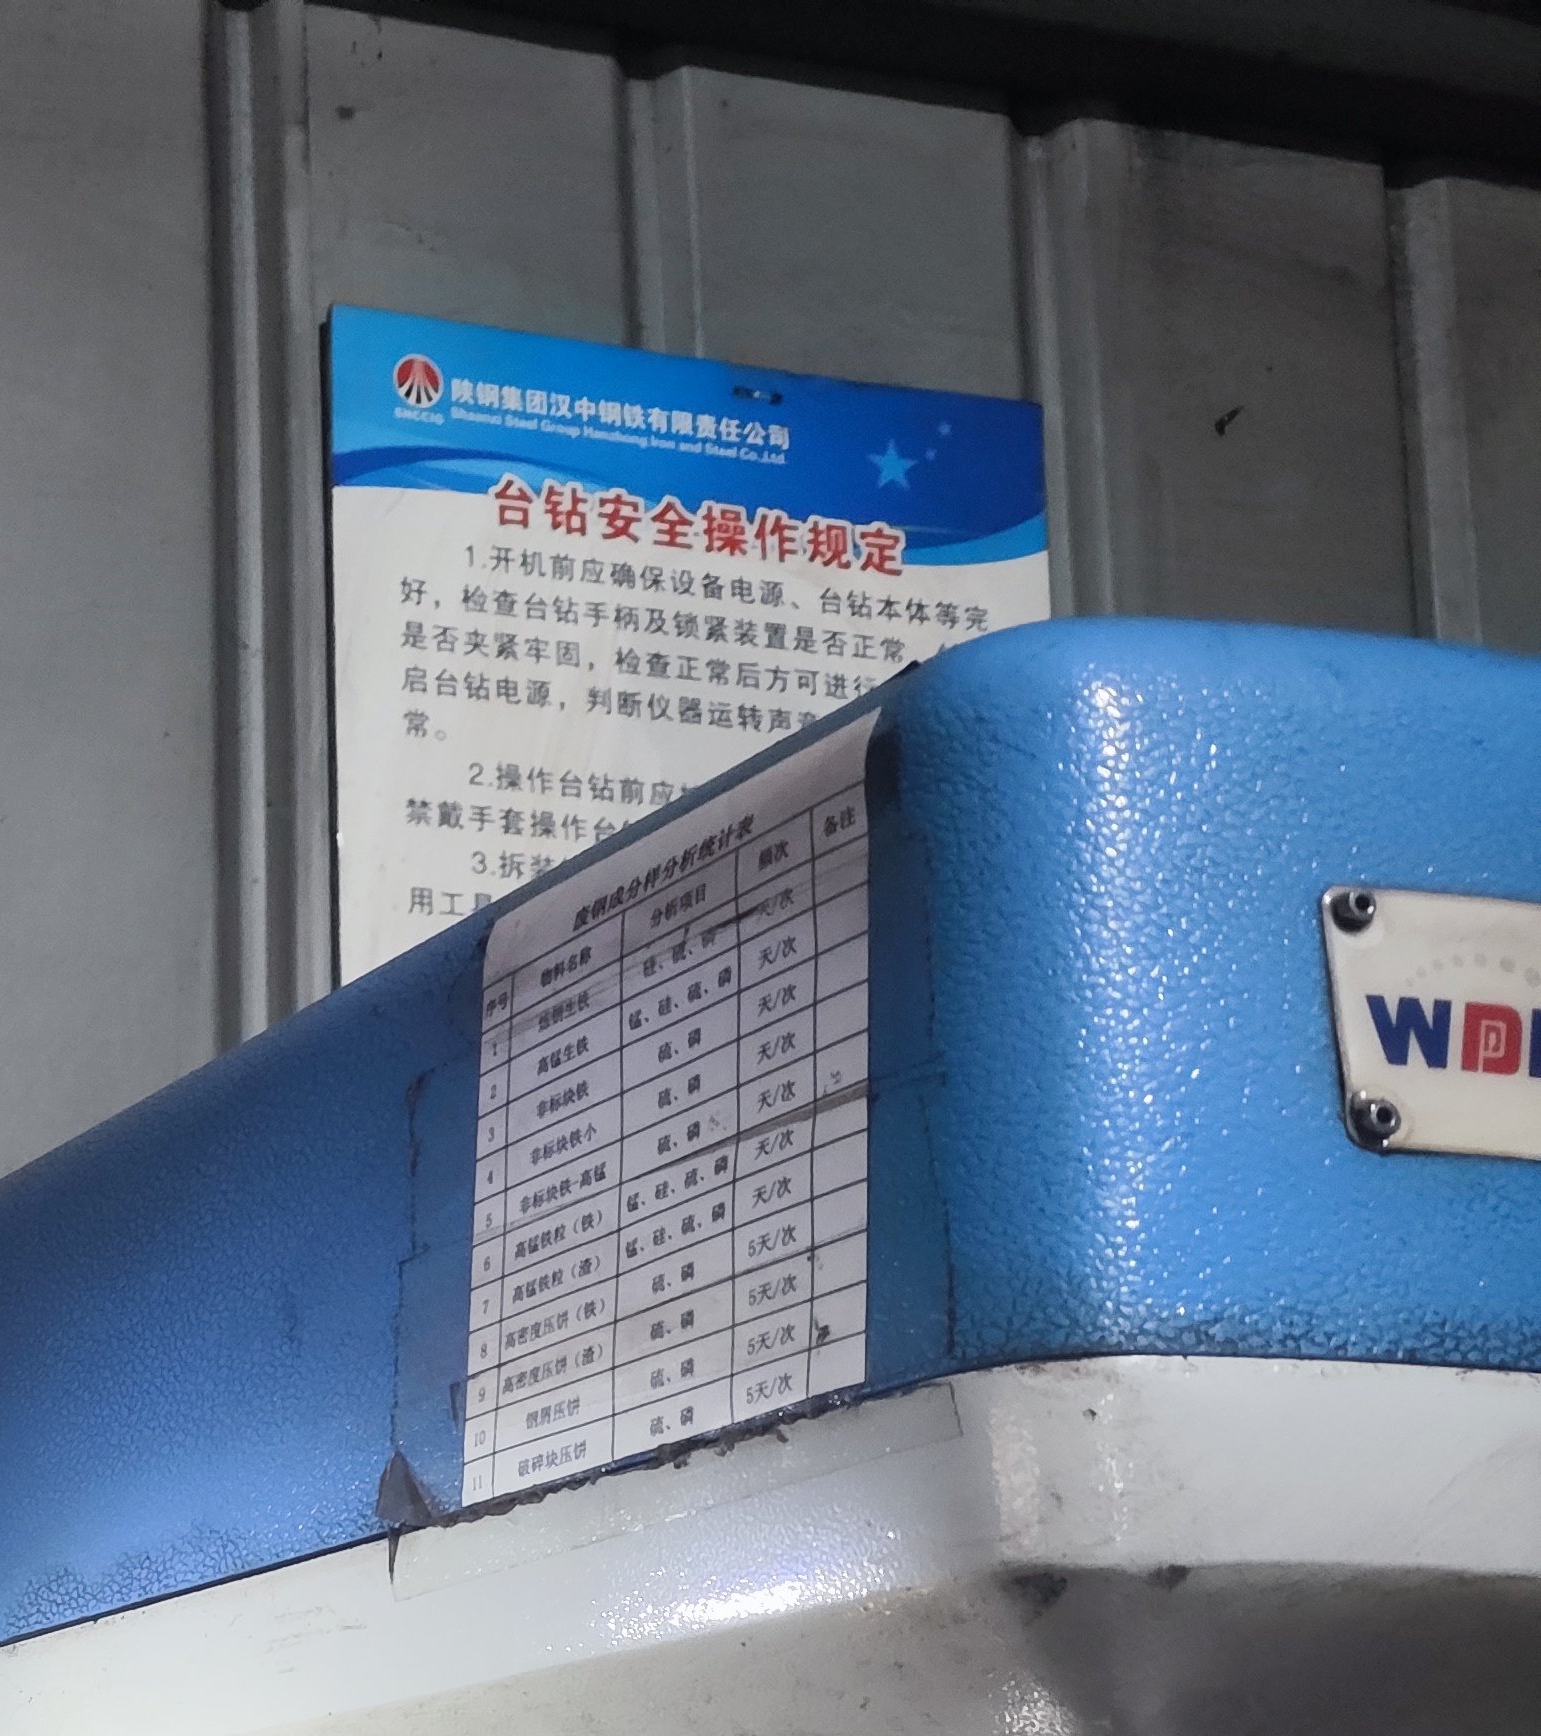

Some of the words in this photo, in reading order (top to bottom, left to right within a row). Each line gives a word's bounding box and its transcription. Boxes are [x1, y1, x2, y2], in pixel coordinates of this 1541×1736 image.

[494, 480, 904, 576] 台钻安全操作规定
[400, 576, 907, 663] 好，检查台钻手柄及锁紧装置是否正常
[403, 708, 448, 742] 常。
[468, 760, 699, 806] 2.操作台钻前应
[405, 797, 631, 843] 禁戴手套操作台
[470, 849, 569, 880] 3.拆装
[650, 883, 706, 929] 分析项目
[487, 1126, 495, 1143] 3
[757, 983, 797, 1018] 天/次
[490, 1084, 497, 1100] 2
[757, 935, 797, 970] 天/次
[1366, 993, 1541, 1078] WD
[485, 1212, 493, 1229] 5
[757, 1079, 797, 1114] 天/次
[486, 1170, 494, 1185] 4
[757, 1031, 796, 1065] 天/次
[482, 1299, 490, 1315] 7
[752, 1176, 792, 1209] 天/次
[483, 1256, 492, 1272] 6
[754, 1128, 795, 1161] 天/次
[478, 1386, 486, 1404] 9
[747, 1273, 797, 1307] 5天/次
[480, 1342, 488, 1360] 8
[747, 1223, 797, 1258] 5天/次
[472, 1476, 483, 1492] 11
[745, 1372, 793, 1405] 5天/次
[473, 1429, 486, 1448] 10
[746, 1322, 796, 1356] 5天/次
